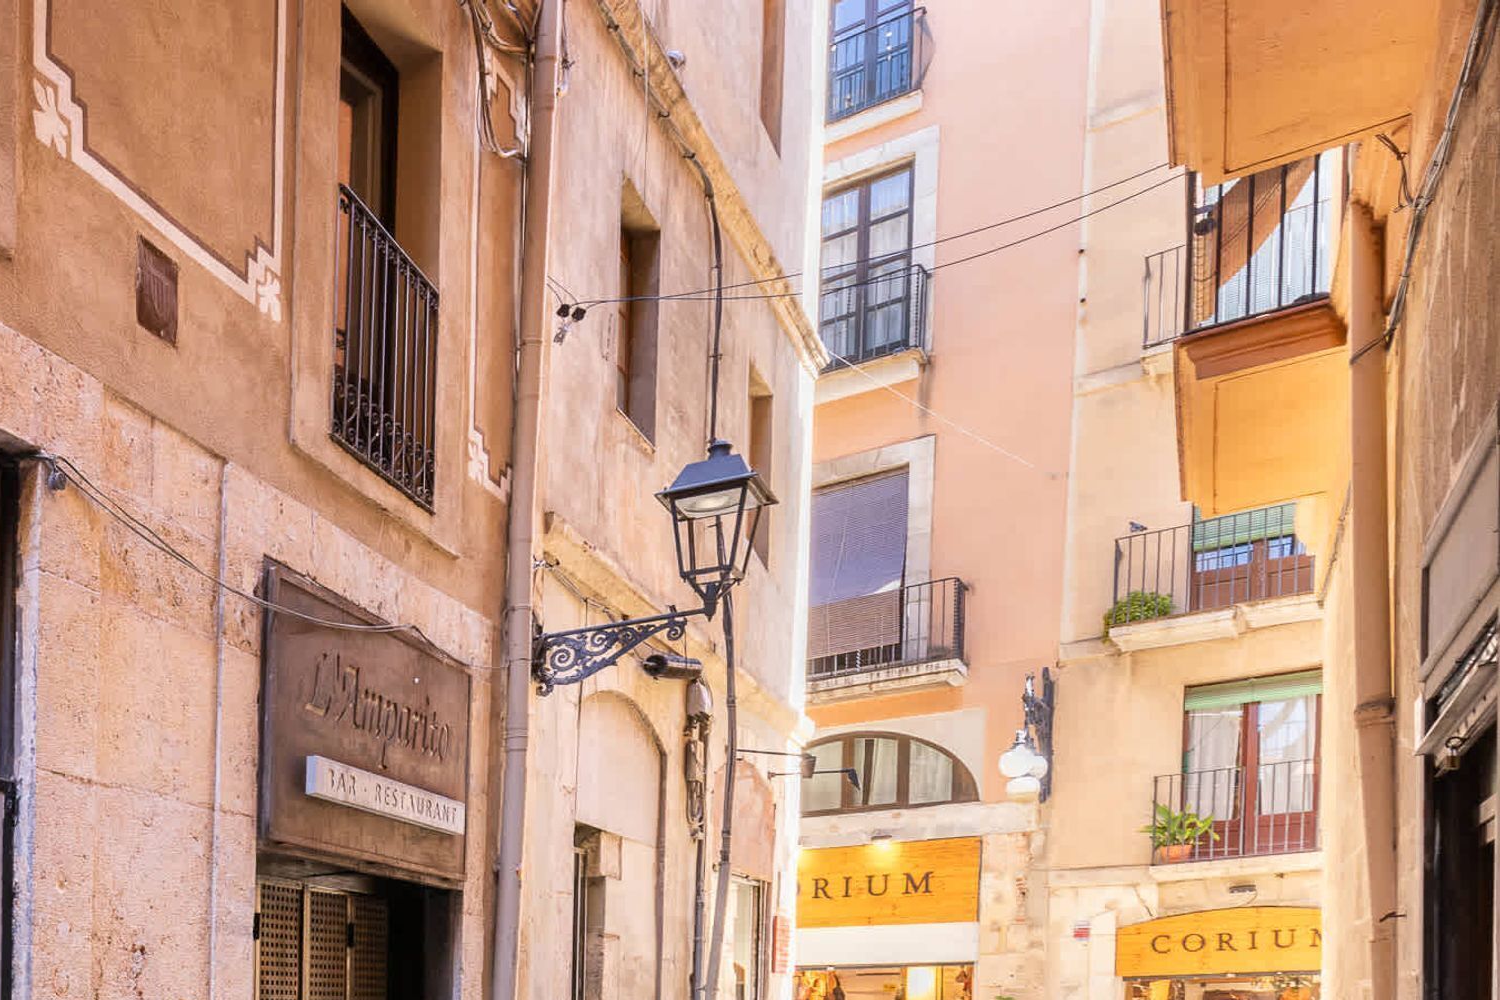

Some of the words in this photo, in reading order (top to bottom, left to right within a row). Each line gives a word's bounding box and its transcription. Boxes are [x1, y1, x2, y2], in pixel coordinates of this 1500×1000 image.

[327, 767, 357, 797] BAR
[375, 782, 457, 823] RESTAURANT
[796, 871, 934, 900] RIUM
